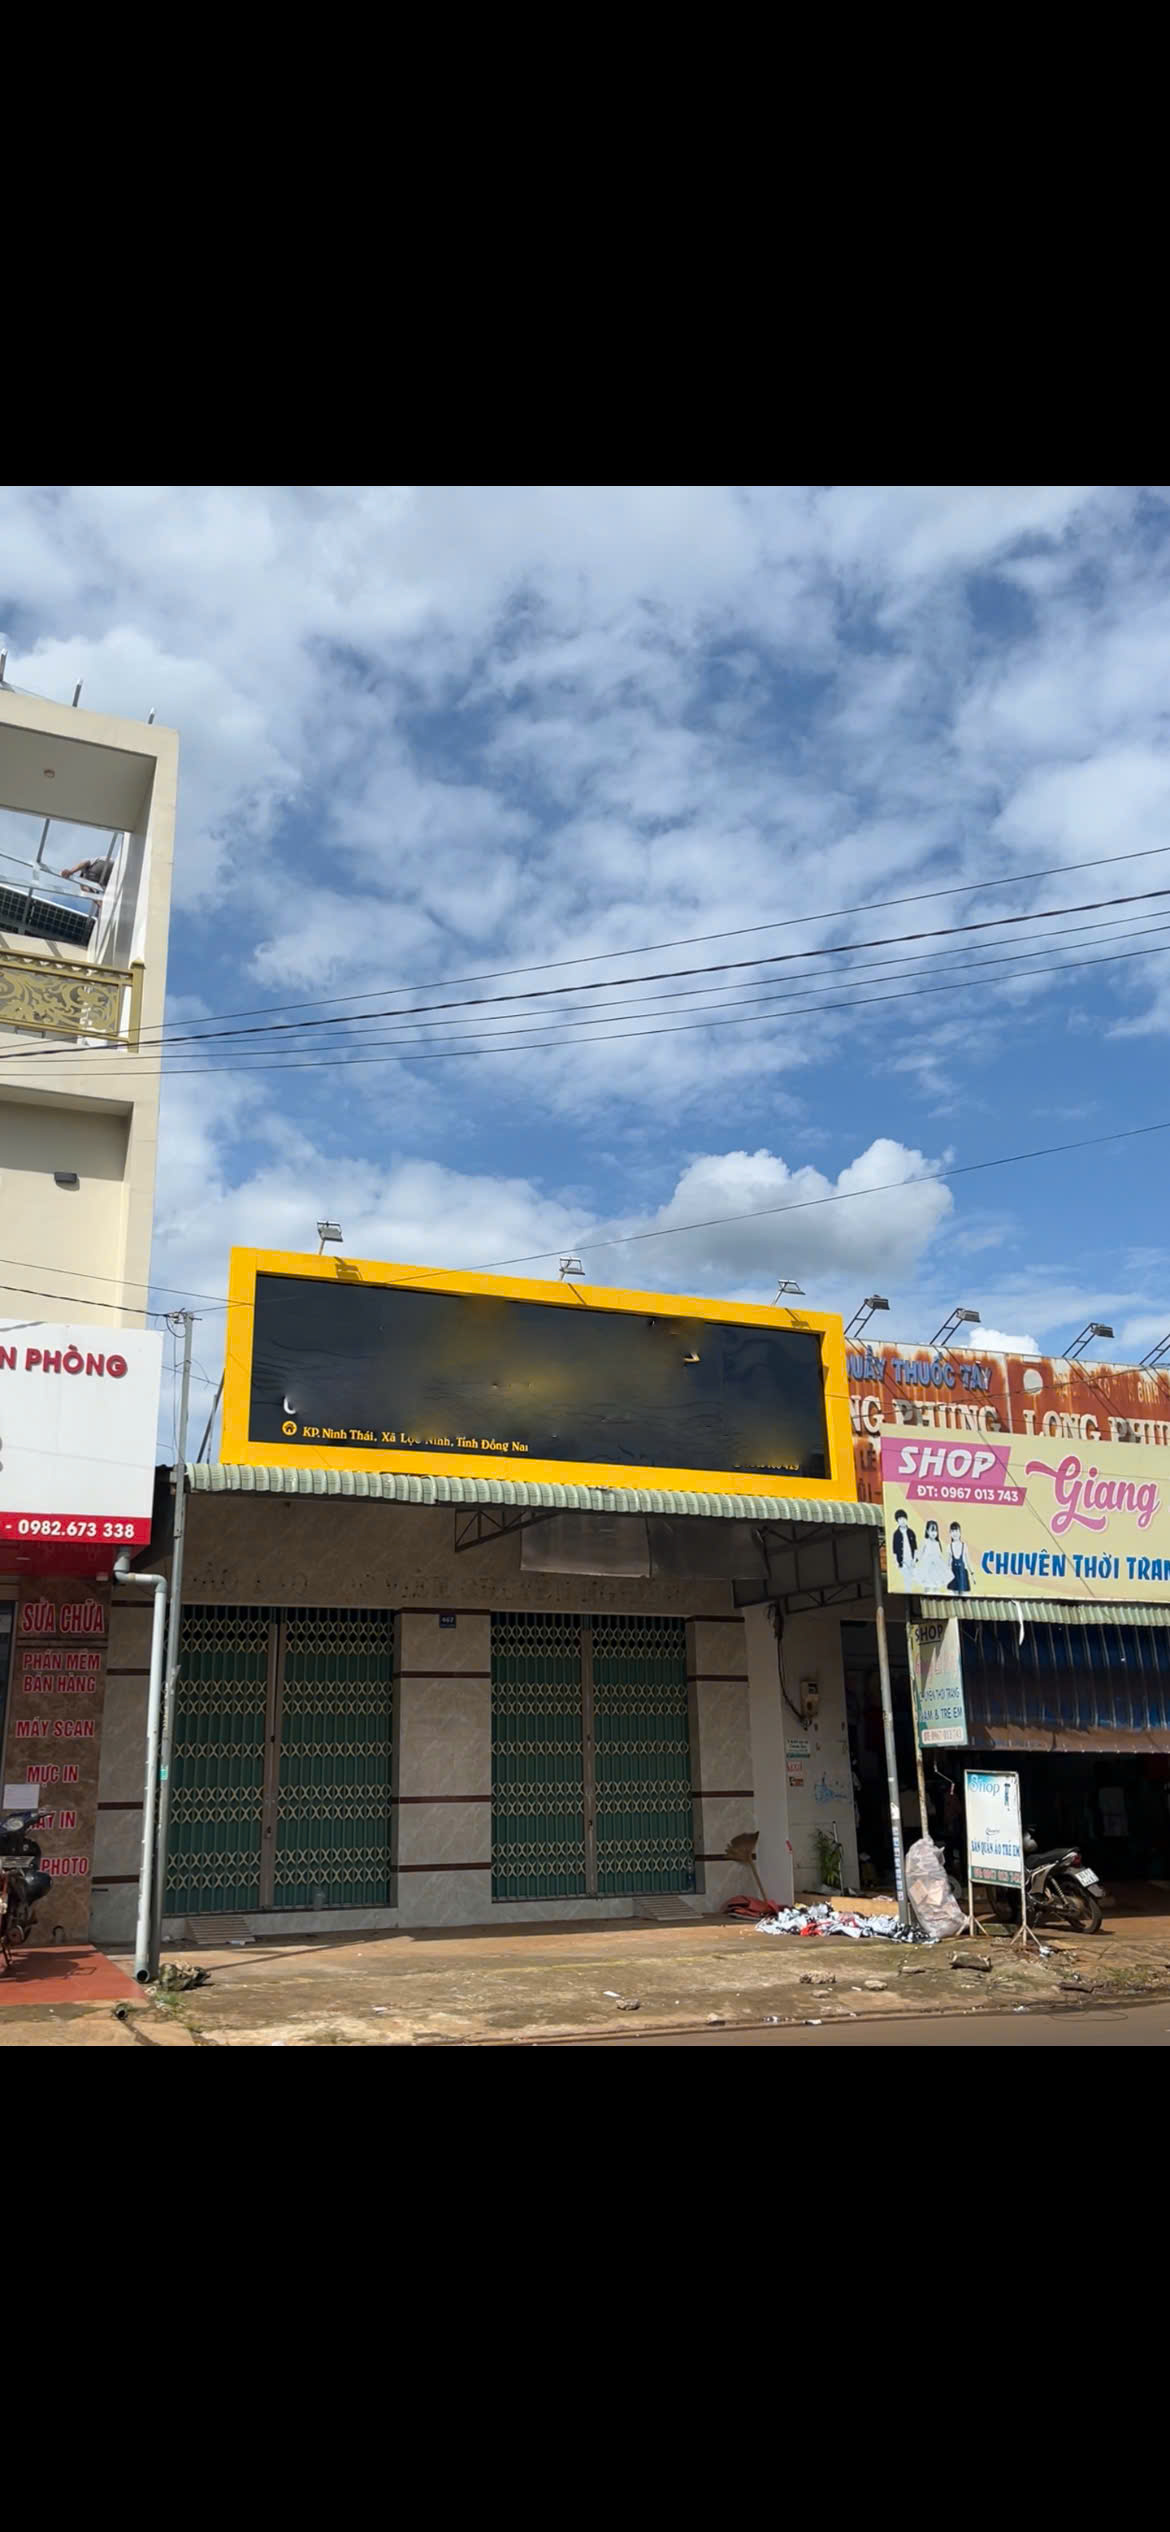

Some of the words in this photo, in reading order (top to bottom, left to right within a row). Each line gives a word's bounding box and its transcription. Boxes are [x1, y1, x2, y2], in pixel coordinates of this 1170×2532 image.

[25, 1344, 128, 1379] PHÒNG
[892, 1352, 956, 1389] THUỐC
[1023, 1409, 1101, 1442] LONG
[303, 1426, 320, 1438] KP.
[322, 1428, 347, 1440] Ninh
[381, 1431, 396, 1443] Xã
[481, 1438, 509, 1453] Đồng
[898, 1445, 996, 1480] SHOP
[916, 1484, 938, 1498] ĐT:
[941, 1487, 971, 1499] 0967
[974, 1488, 995, 1501] 013
[997, 1490, 1019, 1503] 743
[1024, 1454, 1162, 1535] Giang
[18, 1518, 97, 1538] 0982.673
[102, 1522, 136, 1539] 338
[981, 1548, 1067, 1578] CHUYÊN
[1072, 1551, 1120, 1580] THỜI
[22, 1596, 56, 1633] SỬA
[60, 1597, 105, 1634] CHỮA
[915, 1624, 944, 1643] SHOP
[53, 1719, 96, 1738] SCAN
[62, 1764, 79, 1783] IN
[59, 1809, 77, 1830] IN
[39, 1856, 90, 1877] PHOTO
